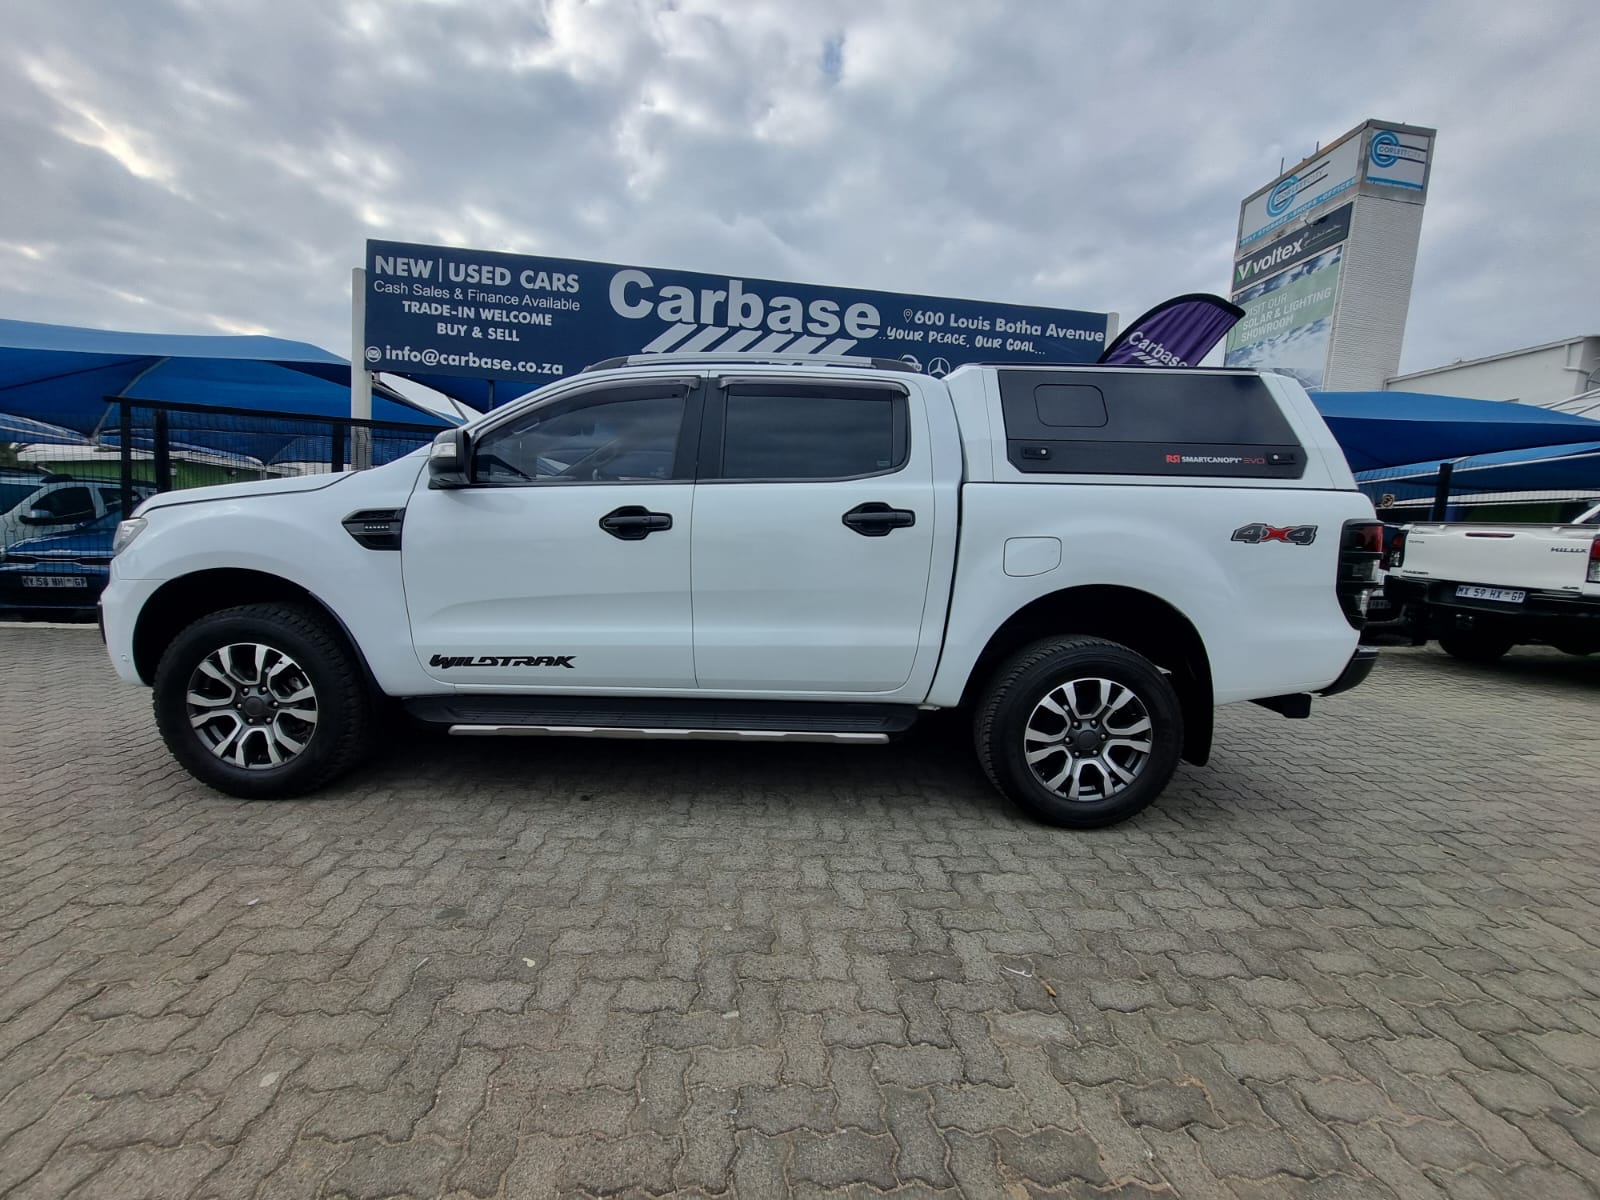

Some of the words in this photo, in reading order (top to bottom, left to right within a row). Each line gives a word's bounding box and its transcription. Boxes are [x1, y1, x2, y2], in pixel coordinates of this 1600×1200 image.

[1253, 238, 1303, 274] voltex
[375, 255, 433, 279] NEW
[448, 262, 511, 286] USED
[519, 270, 579, 293] CARS
[374, 280, 408, 295] Cash
[413, 283, 449, 298] Sales
[454, 288, 464, 300] &
[468, 289, 519, 305] Finance
[522, 295, 580, 311] Available
[608, 269, 881, 338] Carbase
[1243, 312, 1273, 330] SOLAR
[1274, 308, 1281, 318] &
[1283, 288, 1332, 314] LIGHTING
[1268, 293, 1288, 309] OUR
[402, 301, 475, 319] TRADE-IN
[480, 308, 552, 326] WELCOME
[914, 310, 944, 326] 600
[950, 313, 990, 330] Louis
[995, 318, 1041, 336] Botha
[1045, 324, 1105, 341] Avenue
[1241, 314, 1294, 342] SHOWROOM
[437, 322, 467, 337] BUY
[472, 326, 483, 339] &
[488, 328, 520, 342] SELL
[928, 330, 970, 348] PEACE,
[975, 334, 1002, 348] OUR
[386, 345, 563, 375] info@carbase.co.za
[1473, 588, 1486, 597] 59
[1511, 591, 1524, 601] GP
[429, 654, 577, 669] WILDTRAK
